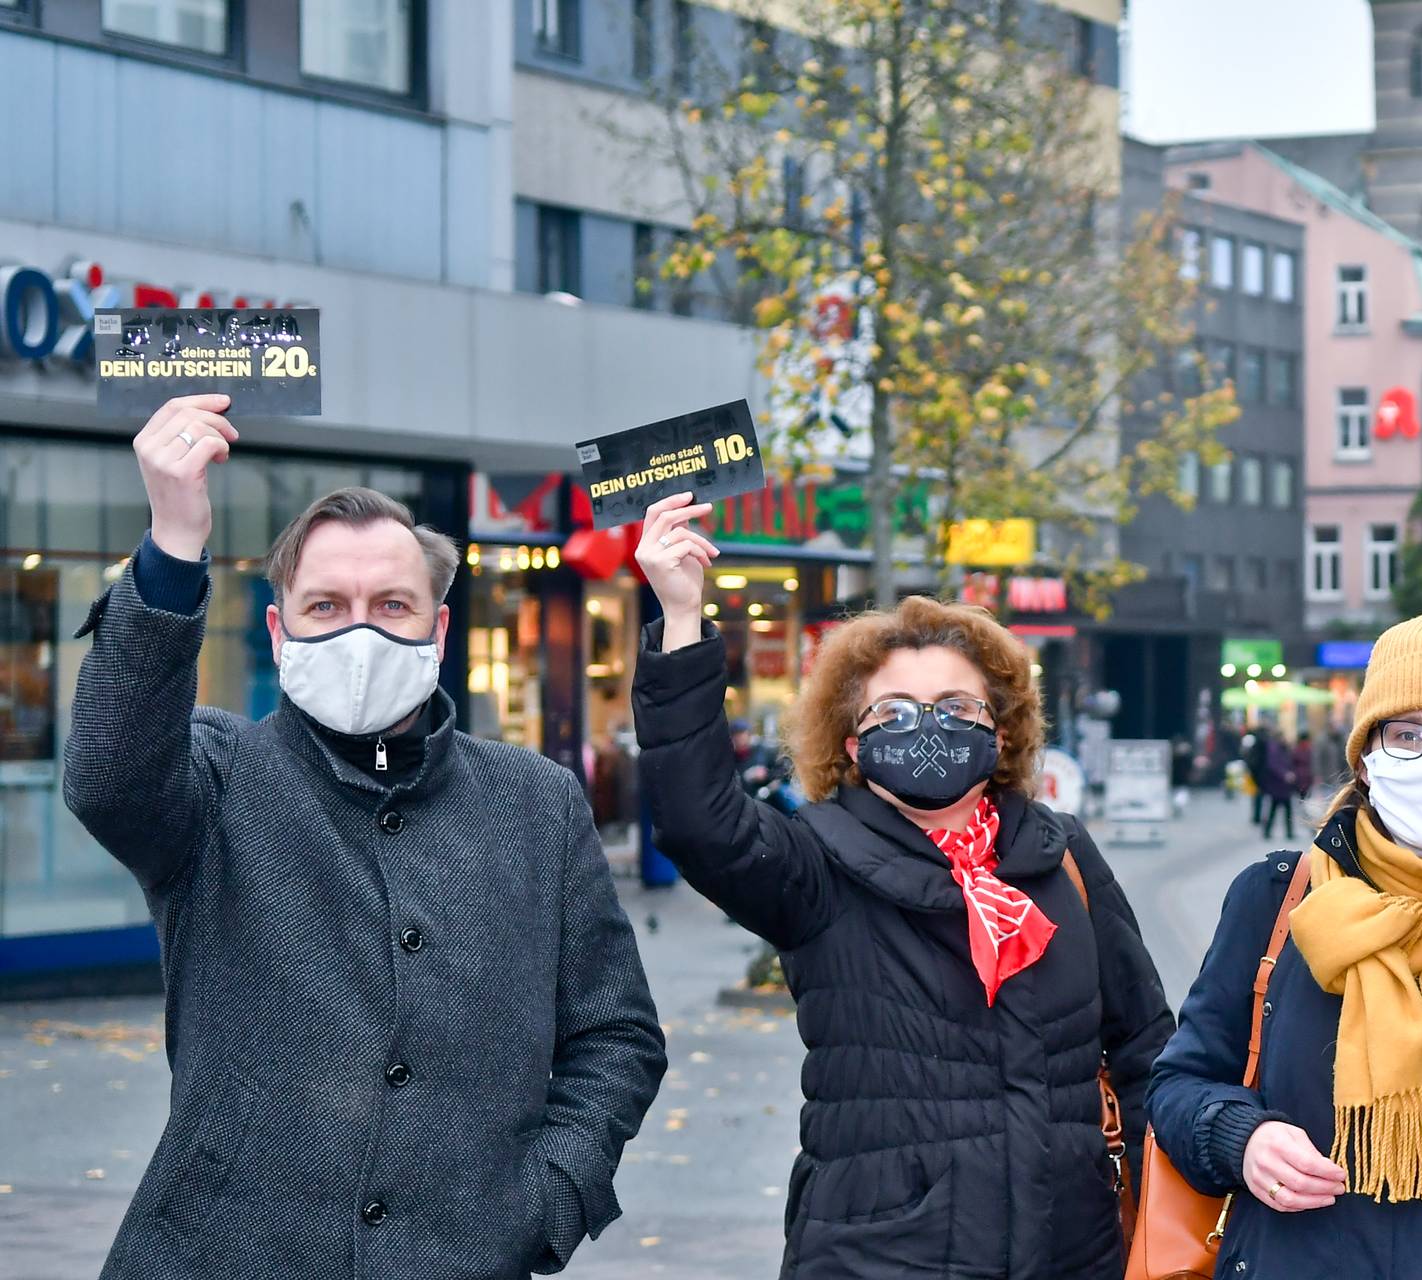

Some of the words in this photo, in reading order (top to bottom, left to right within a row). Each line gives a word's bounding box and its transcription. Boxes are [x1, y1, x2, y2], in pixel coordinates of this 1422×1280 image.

[181, 347, 216, 358] deine
[218, 347, 251, 358] stadt
[264, 346, 317, 378] 20€
[100, 360, 144, 376] DEIN
[147, 360, 252, 377] GUTSCHEIN
[649, 452, 677, 467] deine
[678, 444, 703, 460] stadt
[713, 433, 754, 465] 10€
[590, 476, 625, 498] DEIN
[626, 456, 707, 488] GUTSCHEIN
